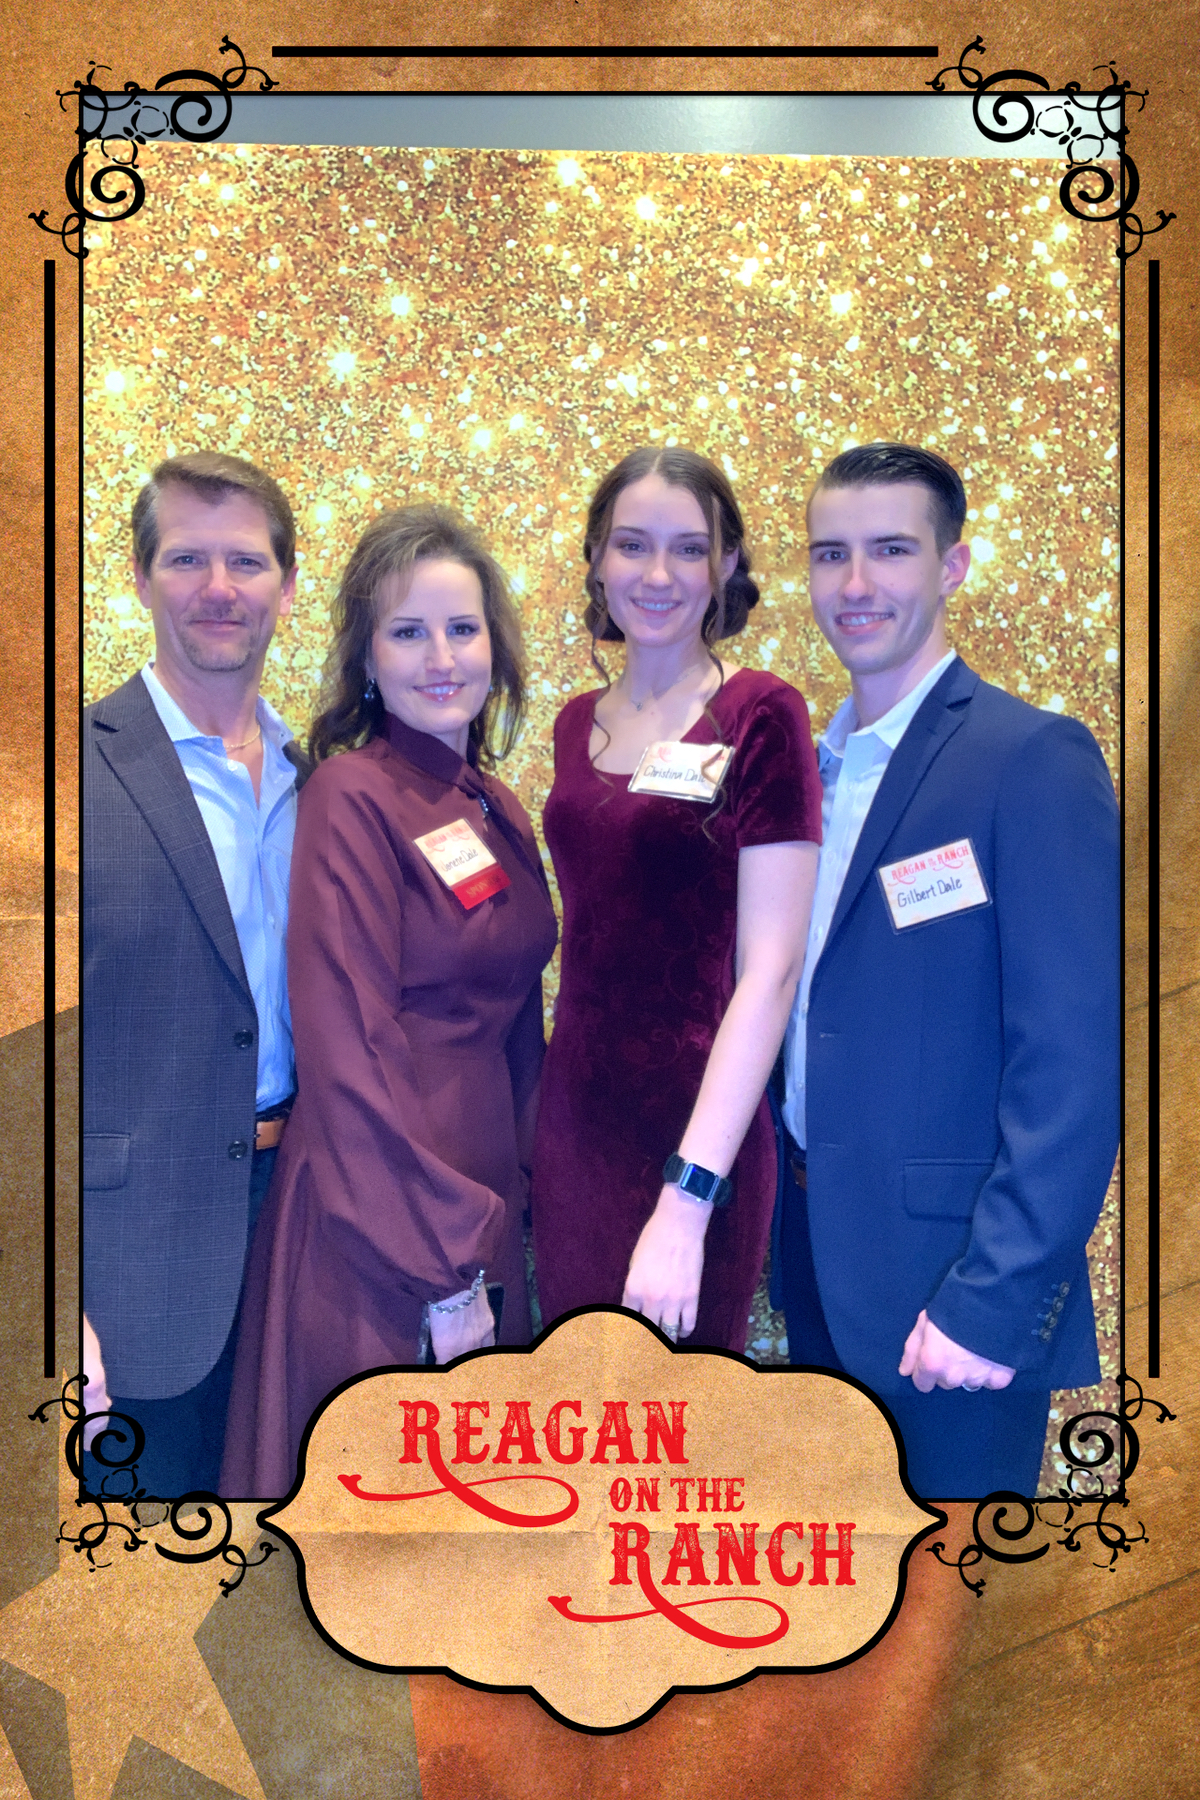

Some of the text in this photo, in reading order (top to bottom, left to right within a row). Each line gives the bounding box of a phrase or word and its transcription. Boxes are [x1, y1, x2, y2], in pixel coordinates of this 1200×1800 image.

[643, 765, 683, 780] Christina
[891, 860, 926, 880] REAGAN
[937, 846, 969, 865] RANCH
[897, 877, 962, 908] Gilbert Dale
